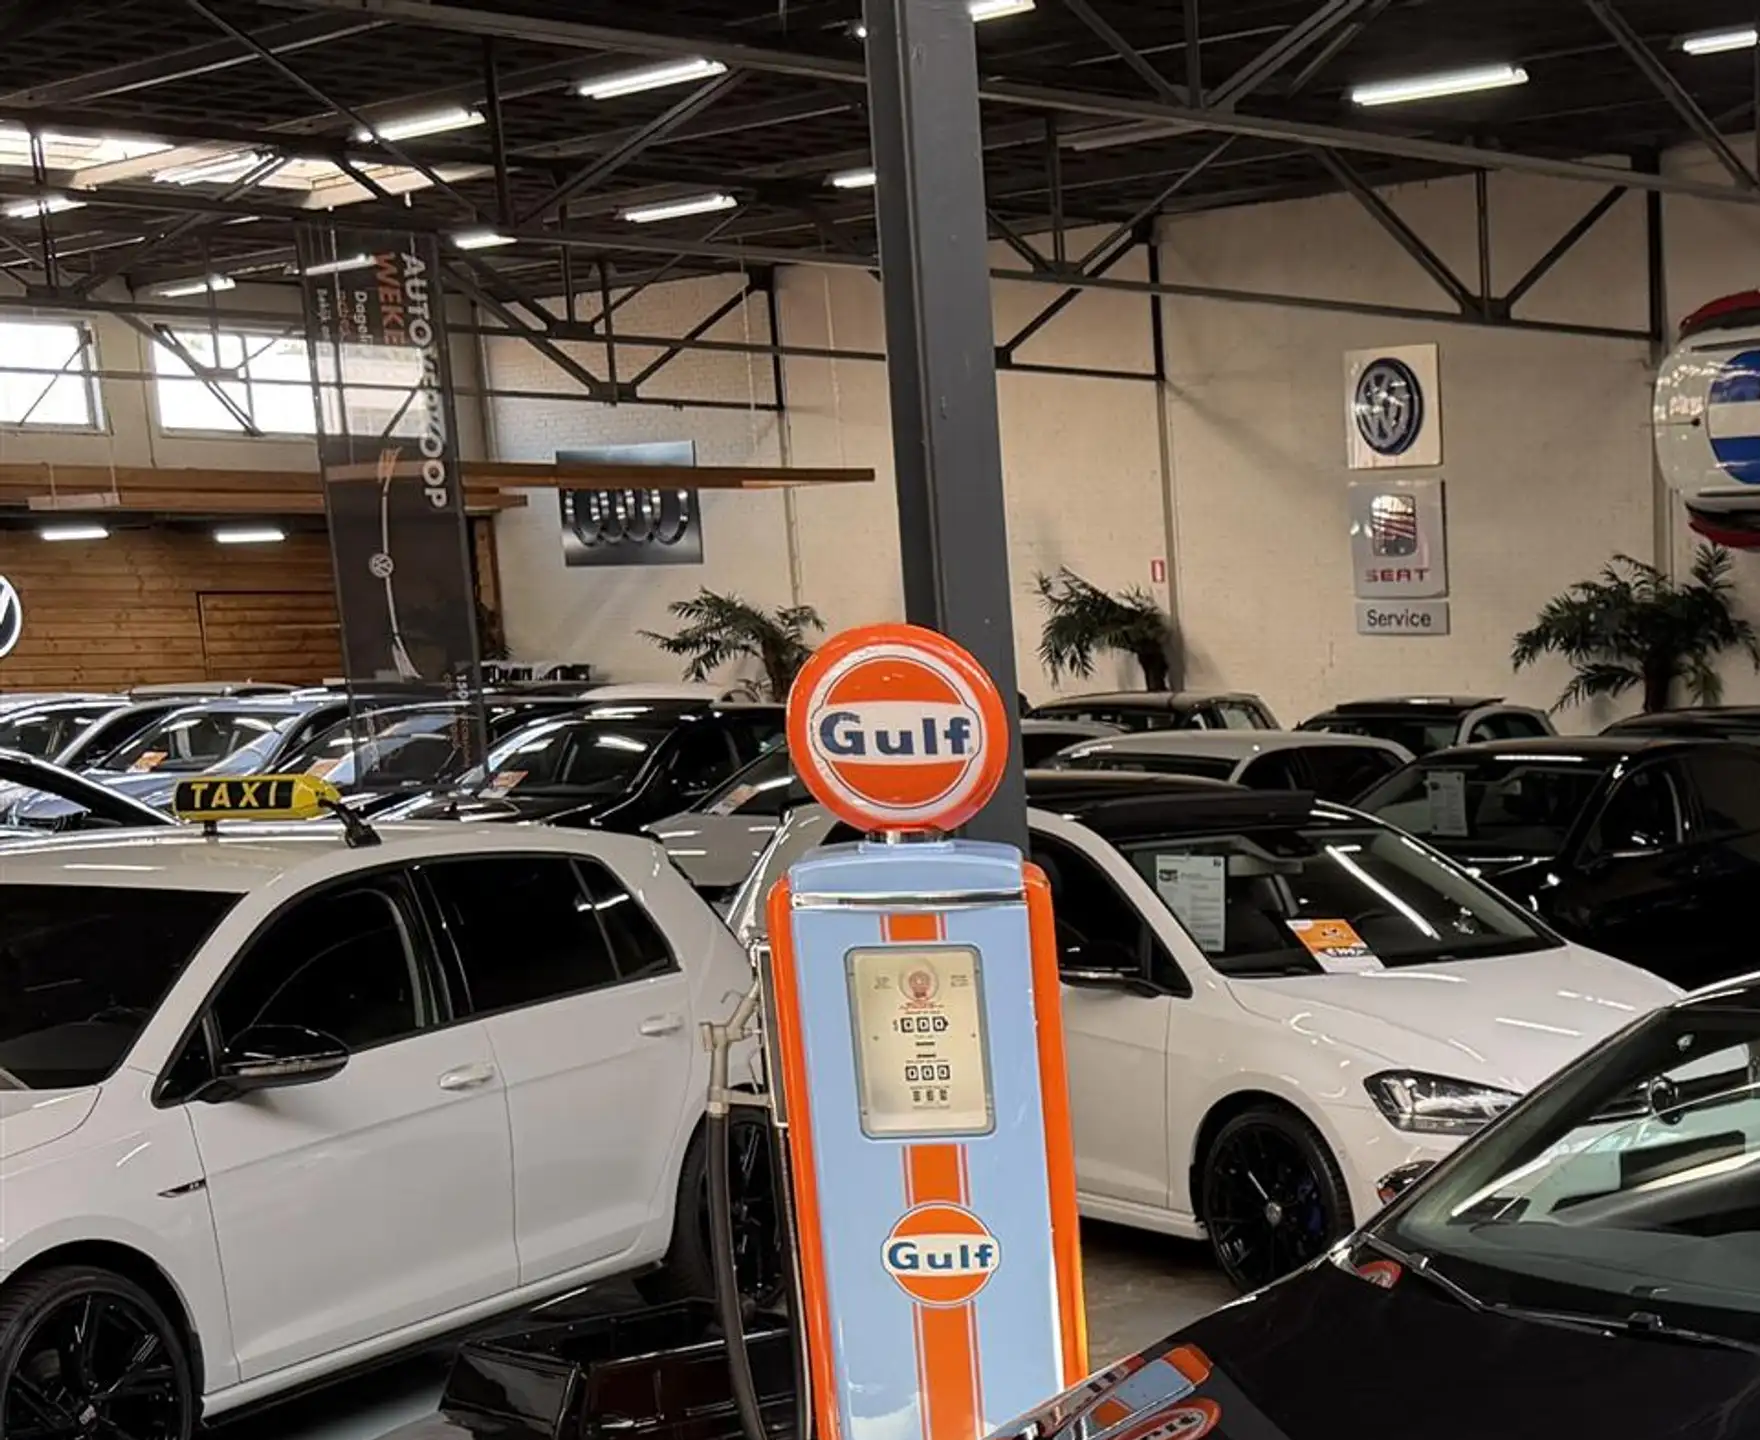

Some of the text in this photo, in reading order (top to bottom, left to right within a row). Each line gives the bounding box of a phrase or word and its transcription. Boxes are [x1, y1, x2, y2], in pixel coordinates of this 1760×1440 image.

[1365, 568, 1430, 582] SEAT
[1366, 609, 1431, 628] Service
[819, 711, 971, 755] Gulf
[190, 781, 278, 808] TAXI
[888, 1242, 993, 1270] Gulf
